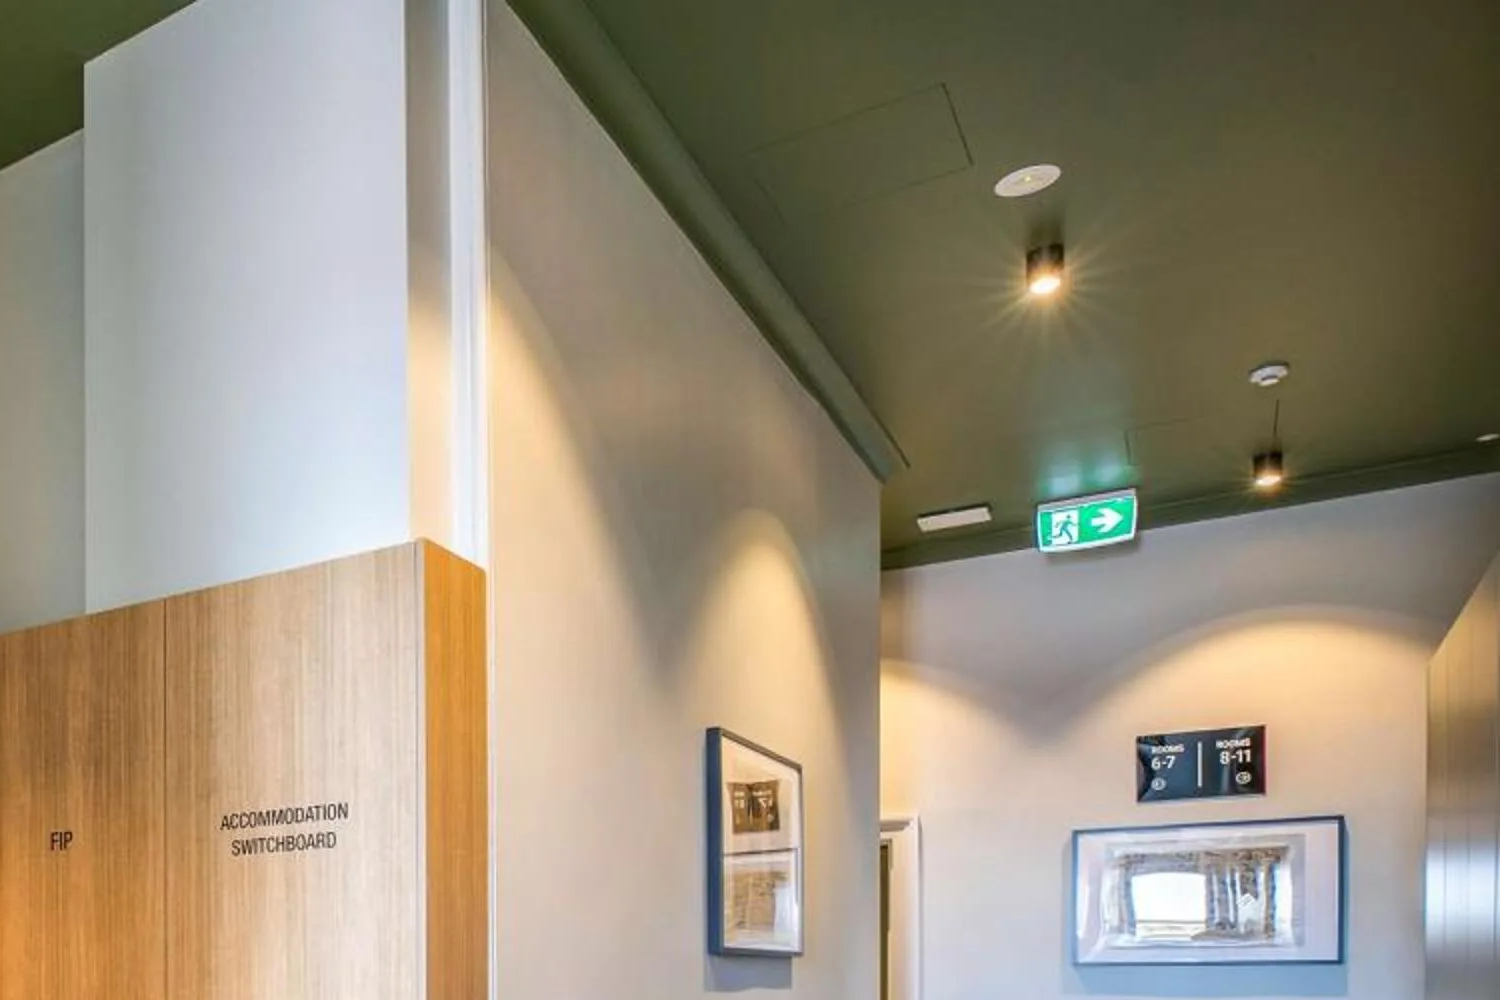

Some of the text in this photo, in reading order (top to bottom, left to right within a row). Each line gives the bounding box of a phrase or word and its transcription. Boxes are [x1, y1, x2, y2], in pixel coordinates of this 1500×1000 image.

[1151, 755, 1177, 770] 6-7
[1219, 750, 1252, 765] 8-11
[220, 802, 349, 831] ACCOMMODATION
[50, 831, 73, 851] FIP
[231, 831, 337, 857] SWITCHBOARD
